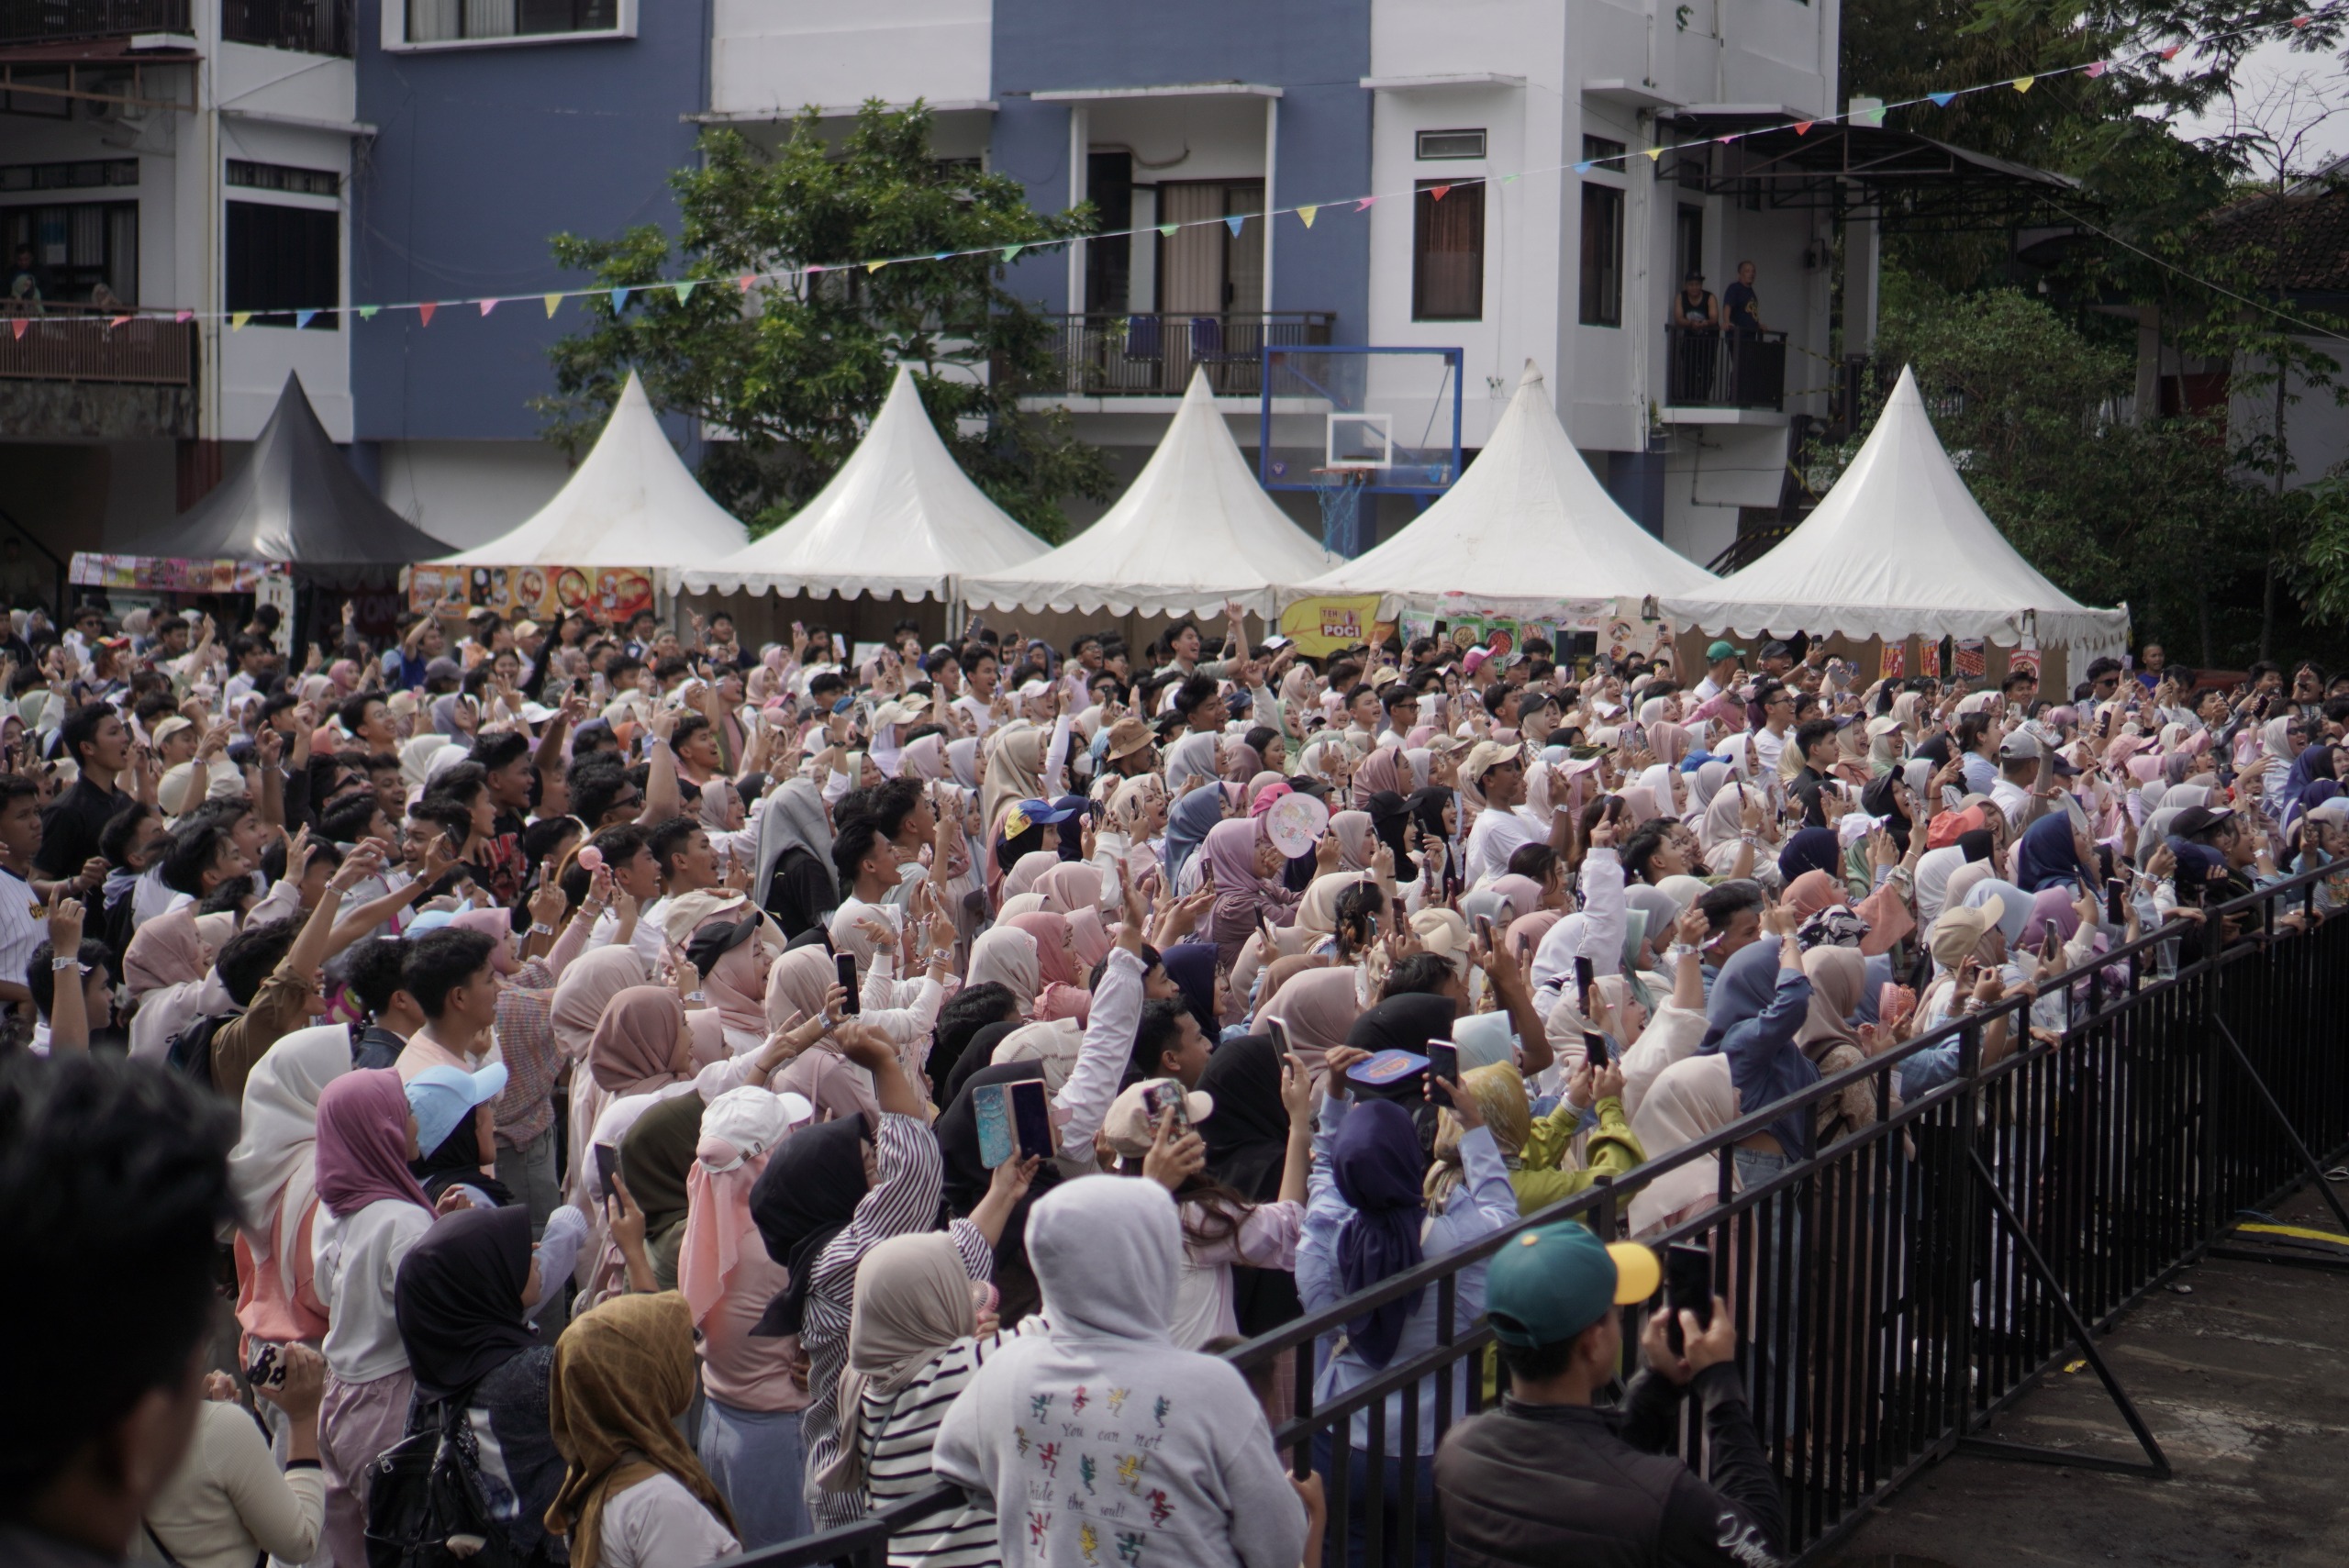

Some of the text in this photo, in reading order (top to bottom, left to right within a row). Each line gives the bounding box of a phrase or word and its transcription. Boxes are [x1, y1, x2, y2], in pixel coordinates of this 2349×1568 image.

[1324, 625, 1360, 637] POCI
[1062, 1423, 1163, 1451] You can not
[1029, 1481, 1126, 1518] hide the soul!
